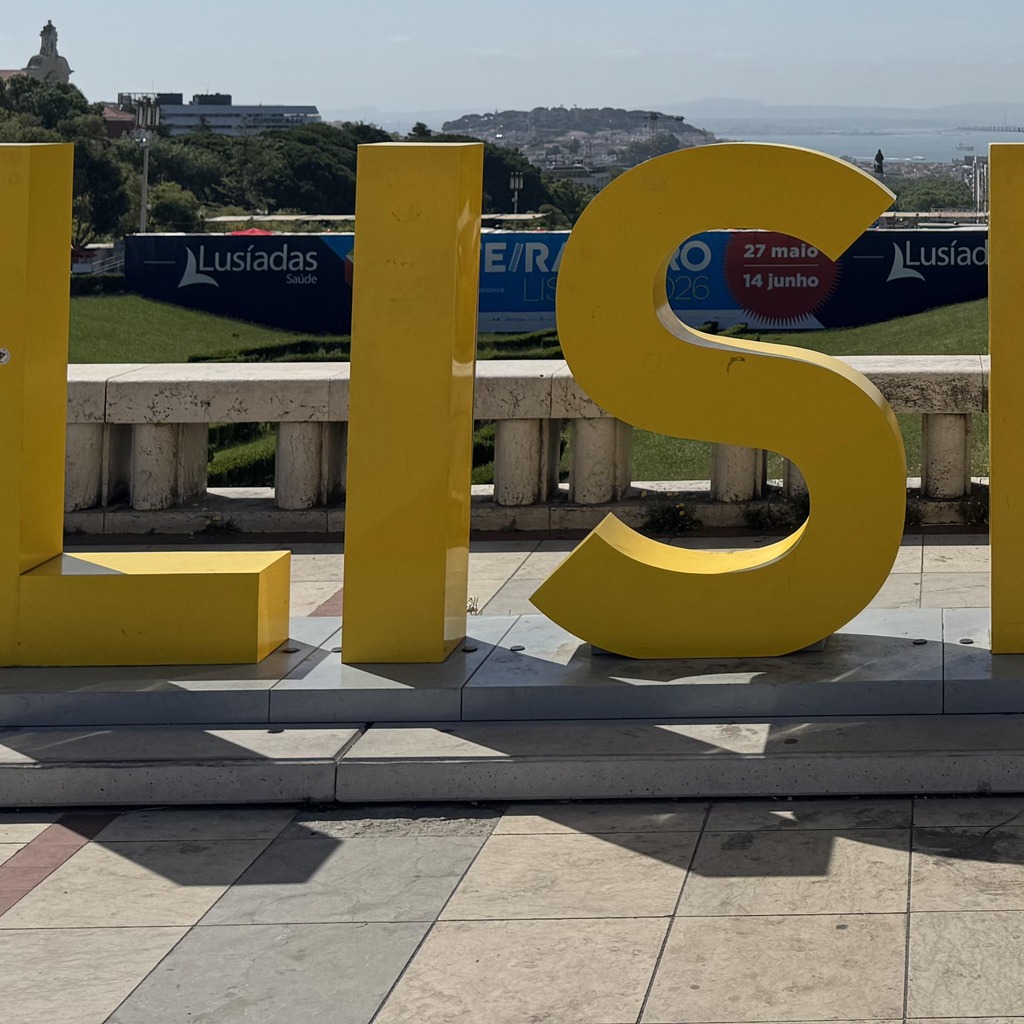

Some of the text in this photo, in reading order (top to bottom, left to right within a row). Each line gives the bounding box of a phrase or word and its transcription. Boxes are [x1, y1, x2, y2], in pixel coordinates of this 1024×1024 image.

[200, 244, 318, 271] Lusíadas
[744, 244, 818, 258] 27 maio
[905, 239, 989, 266] Lusíad
[286, 273, 318, 285] Saúde
[743, 273, 819, 290] 14 junho
